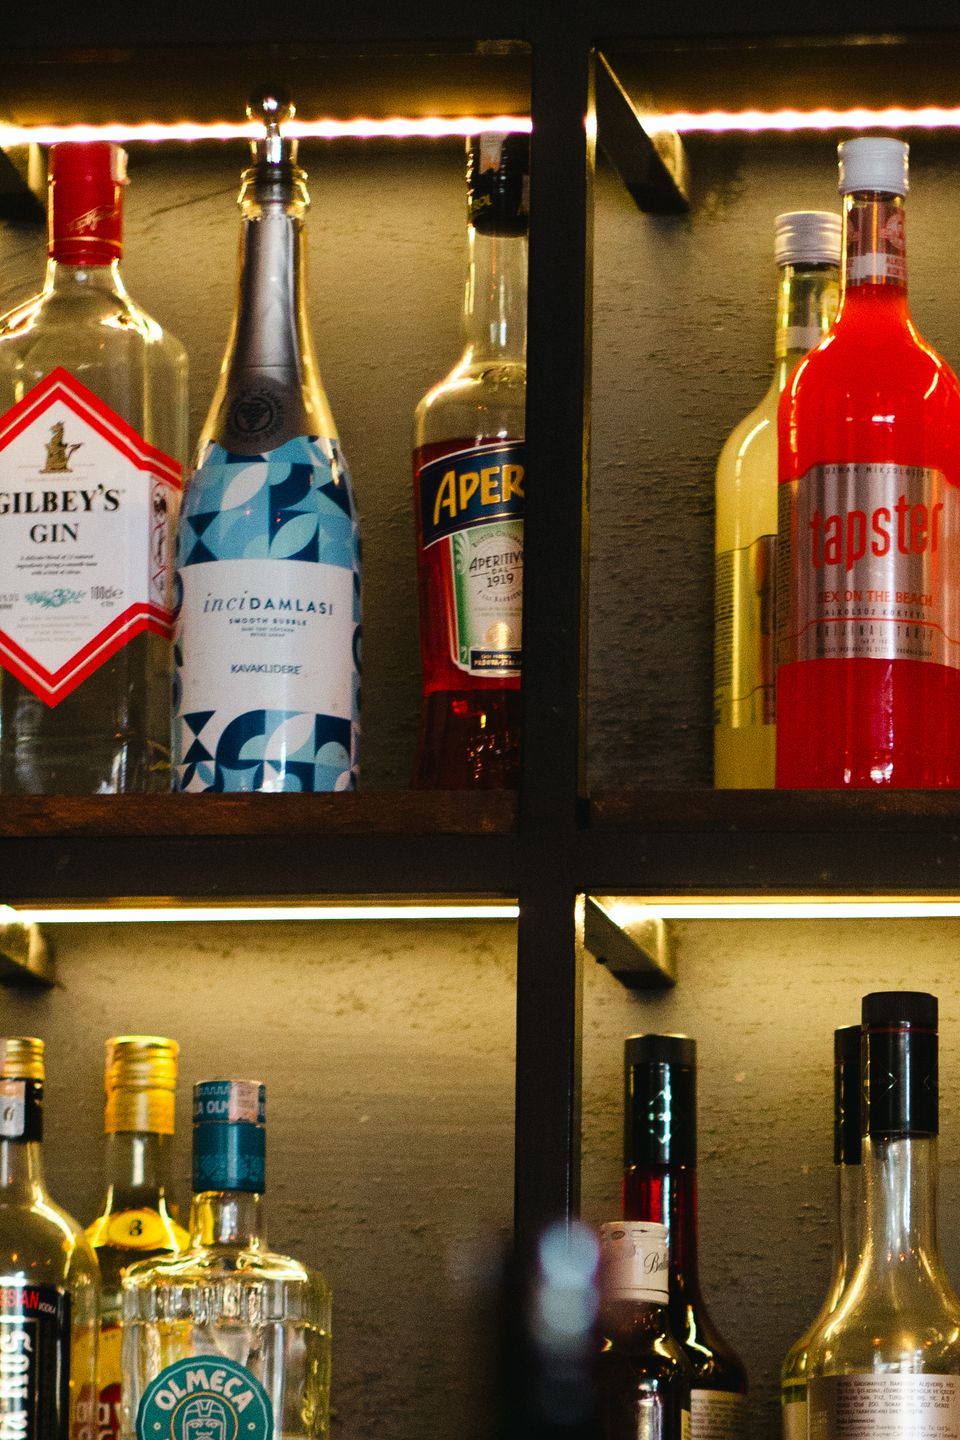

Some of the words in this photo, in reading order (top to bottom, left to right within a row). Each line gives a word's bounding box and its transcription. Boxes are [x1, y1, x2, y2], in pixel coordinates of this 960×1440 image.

[0, 484, 120, 514] GILBEY'S
[433, 464, 525, 525] APER
[29, 523, 79, 543] GIN
[809, 495, 944, 573] tapster
[469, 550, 523, 571] APERITIV
[487, 573, 513, 588] 1919
[845, 590, 862, 602] ON
[867, 590, 891, 603] THE
[896, 591, 933, 608] BEACH
[273, 618, 307, 626] BUBBLE
[230, 664, 302, 675] KAVAKLIDERE
[128, 1219, 142, 1237] 3
[154, 1369, 255, 1414] OLMECA
